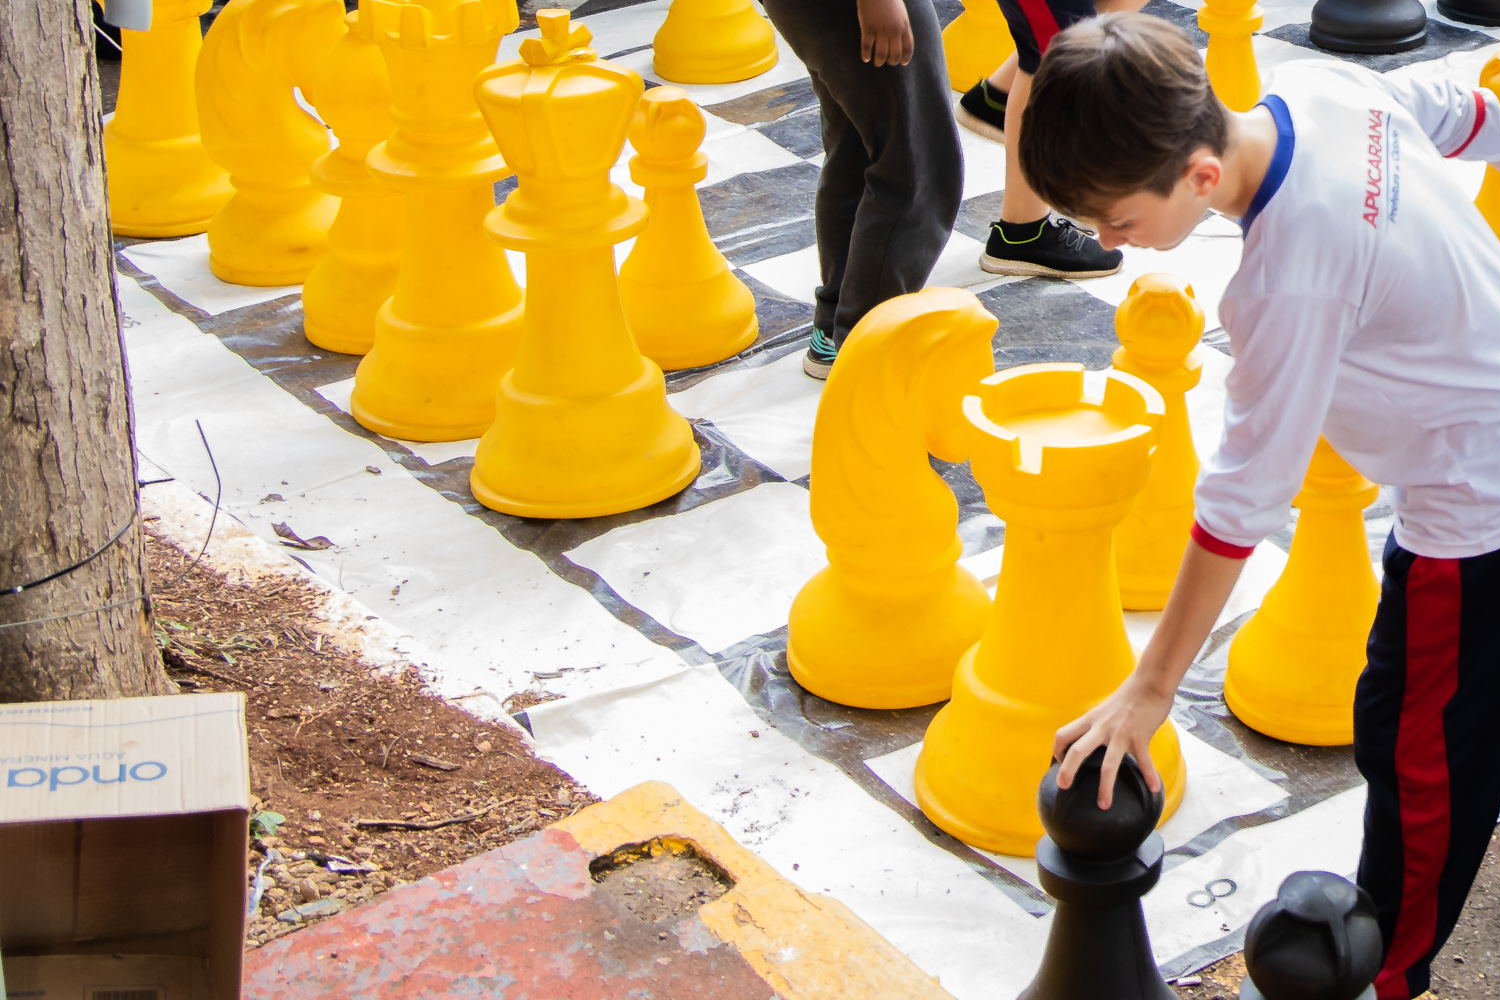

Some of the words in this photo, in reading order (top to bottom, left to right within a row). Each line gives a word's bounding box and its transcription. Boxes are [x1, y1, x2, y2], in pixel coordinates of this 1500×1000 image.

[1362, 109, 1384, 229] APUCARANA
[0, 754, 70, 764] MINERA
[76, 750, 127, 763] ÁGUA
[7, 761, 168, 792] onda
[1186, 879, 1237, 908] 8
